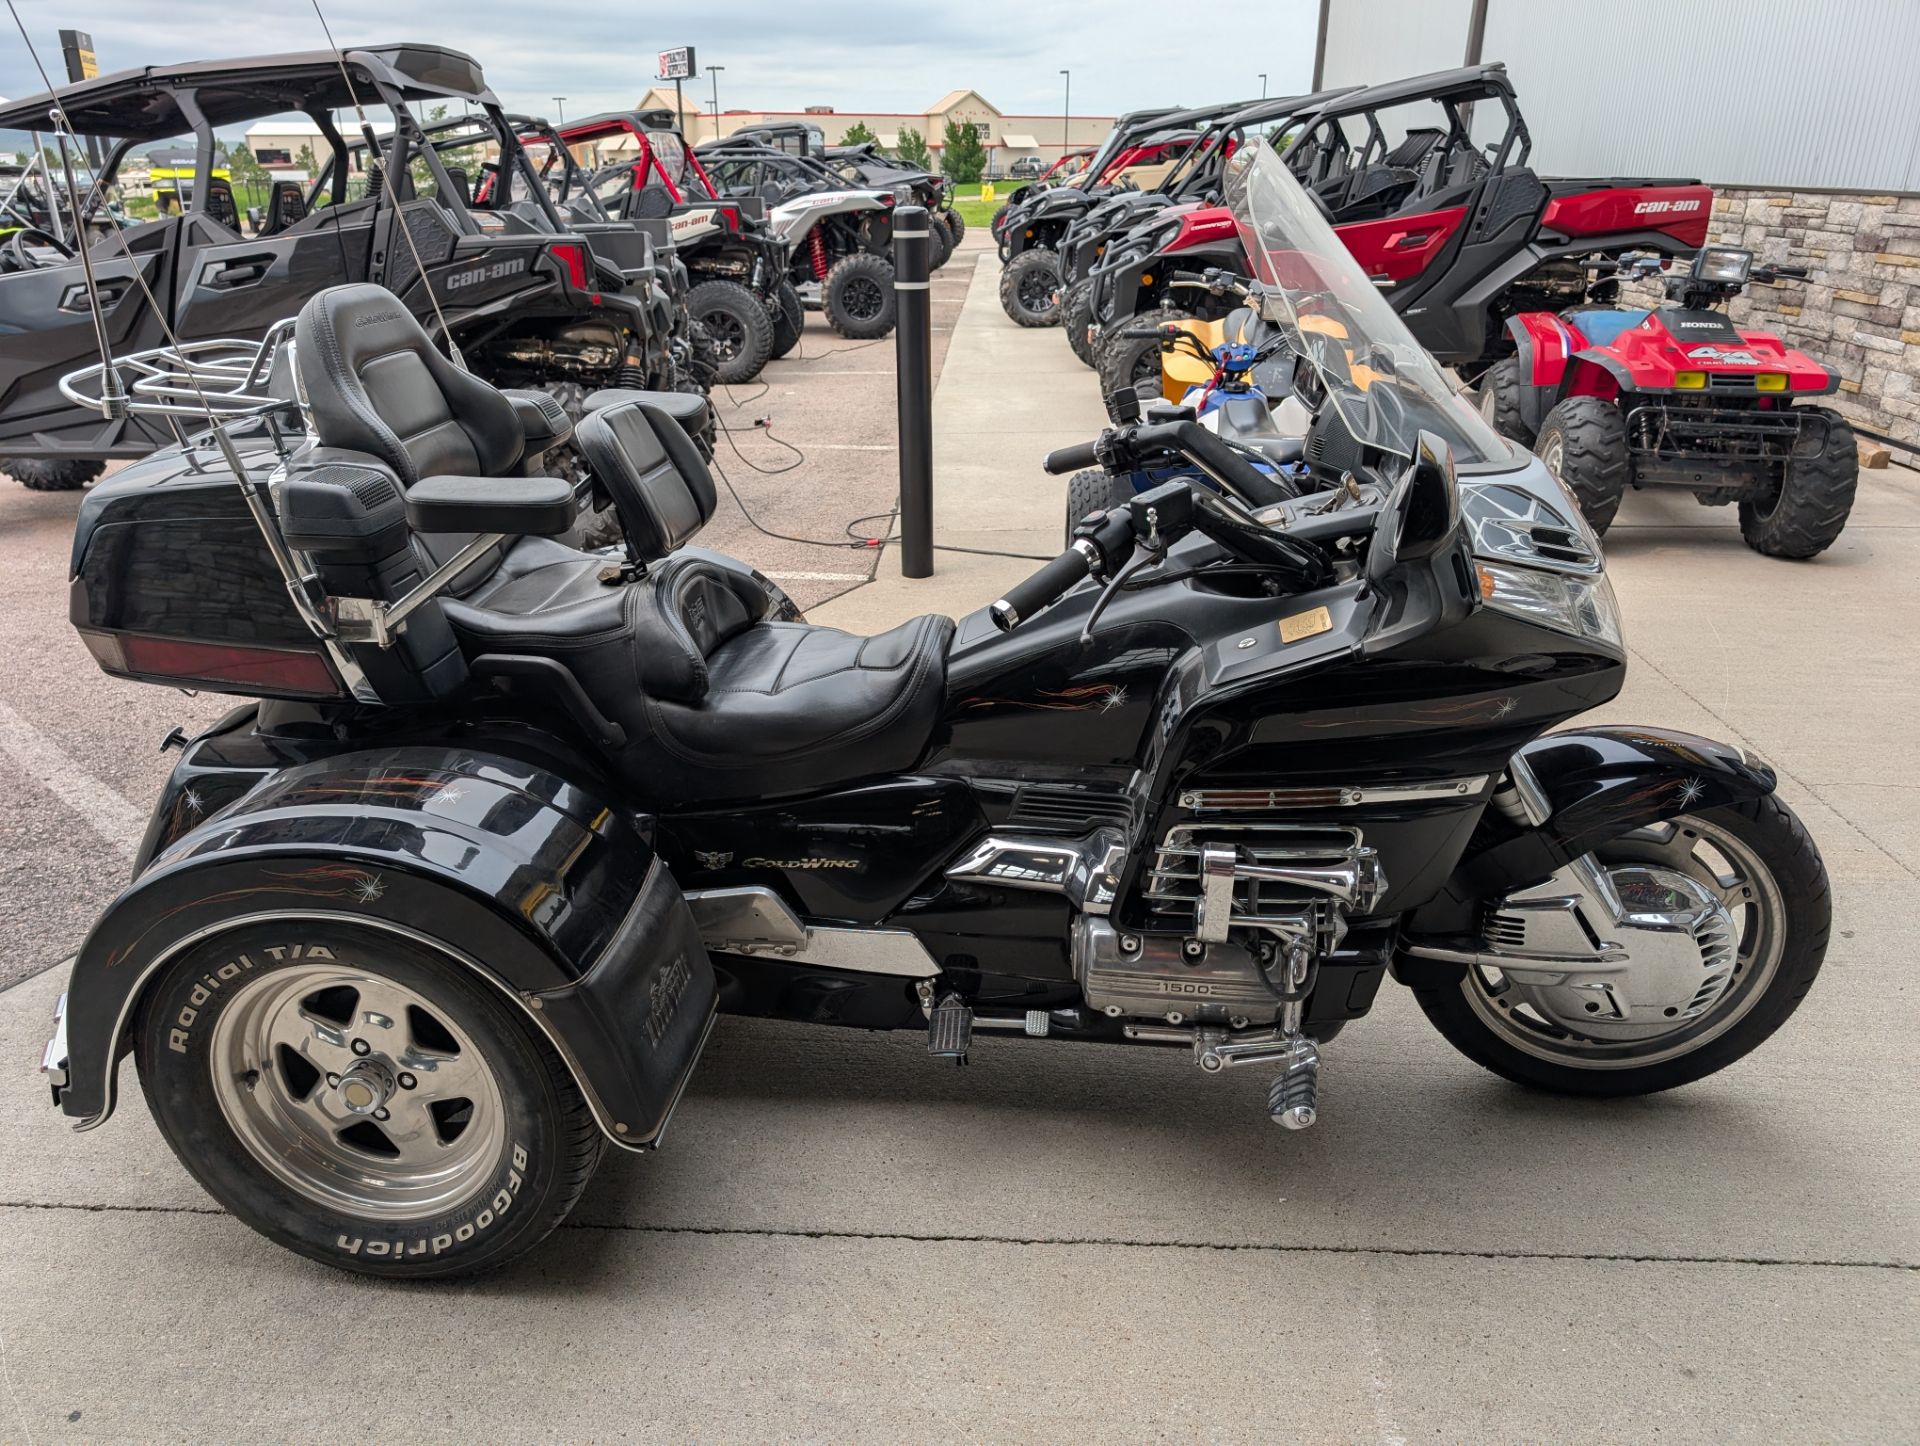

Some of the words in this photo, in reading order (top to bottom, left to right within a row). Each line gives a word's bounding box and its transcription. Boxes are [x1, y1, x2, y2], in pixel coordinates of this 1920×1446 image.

[1634, 200, 1700, 214] can-am
[447, 258, 525, 290] can-am
[1680, 321, 1725, 329] HONDA
[168, 953, 255, 1055] Radial
[263, 944, 337, 961] T/A
[1162, 982, 1210, 995] 1500
[337, 1142, 529, 1260] BFGoodrich
